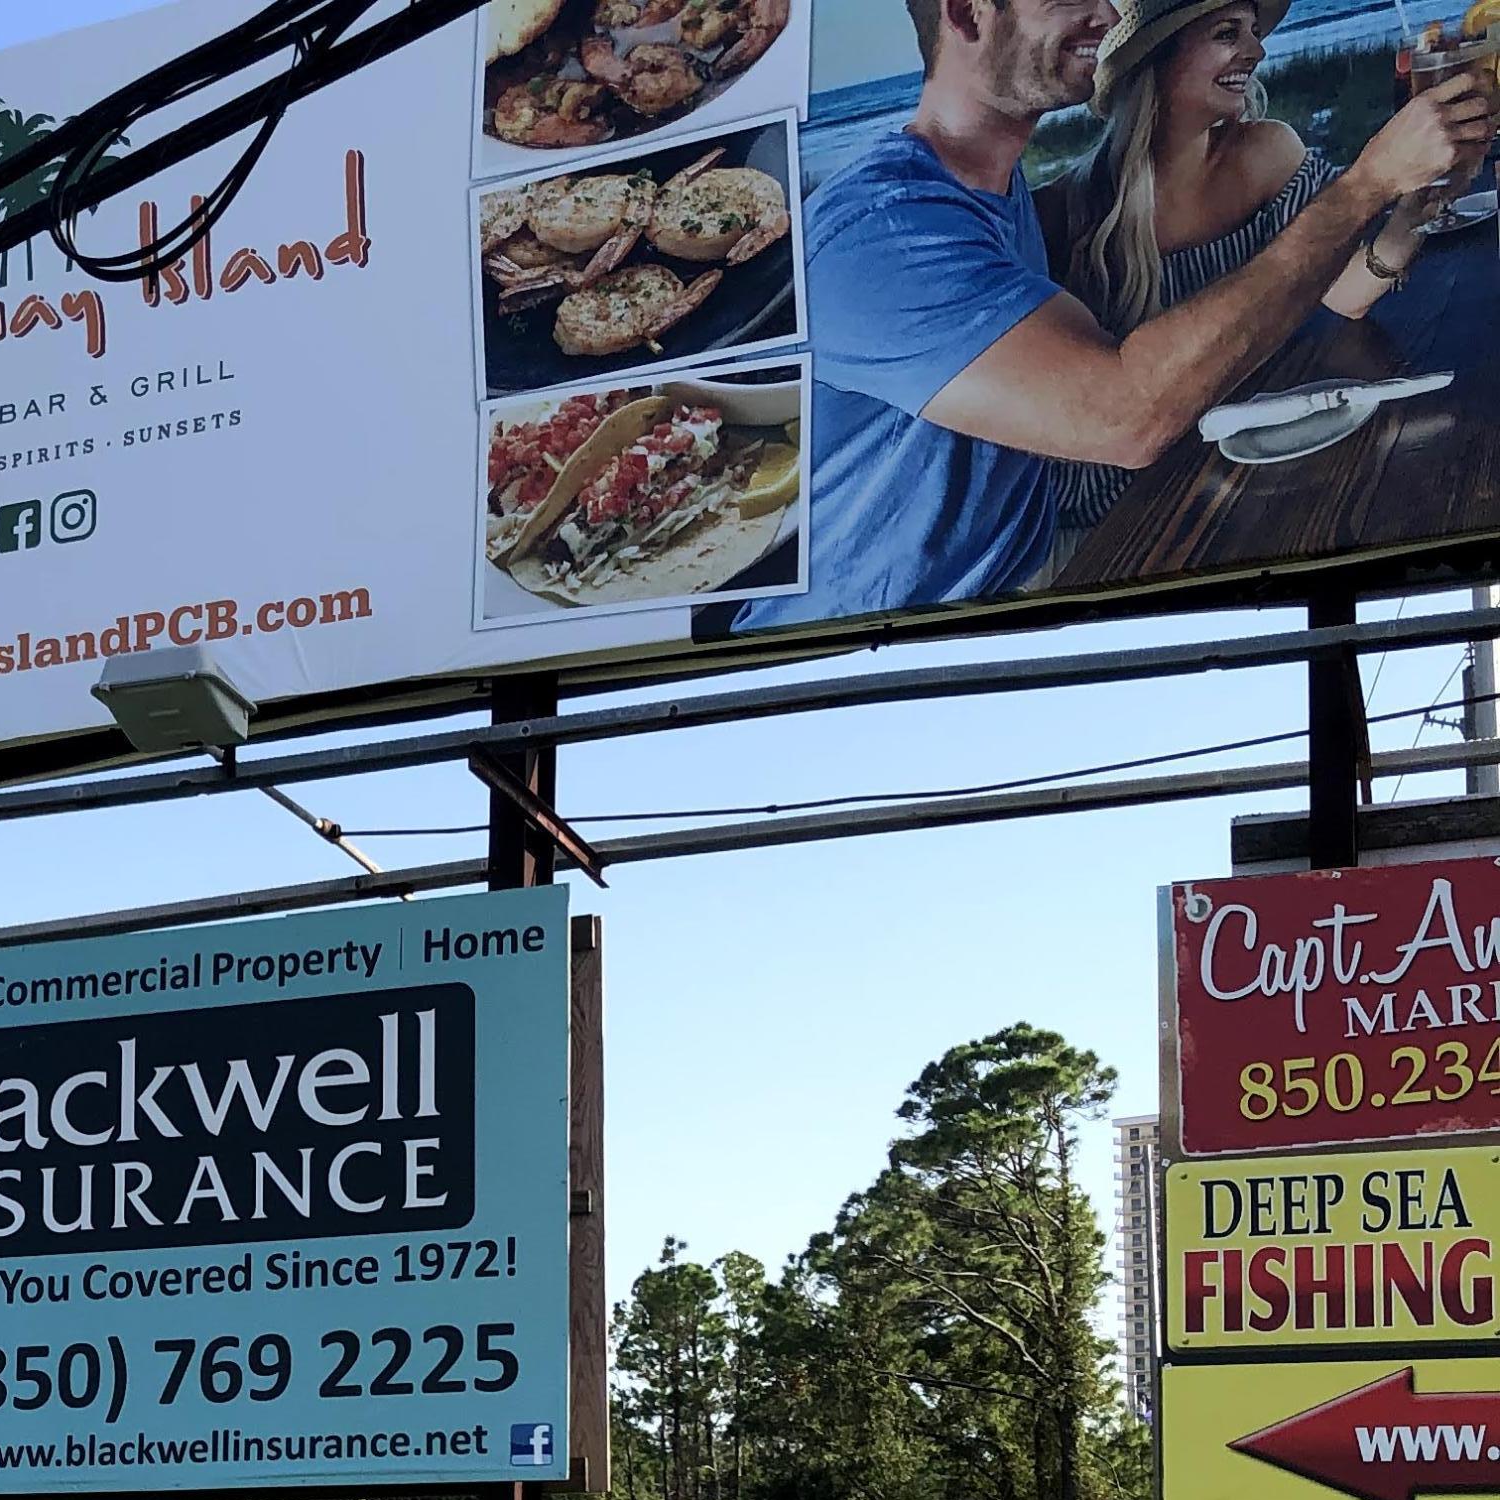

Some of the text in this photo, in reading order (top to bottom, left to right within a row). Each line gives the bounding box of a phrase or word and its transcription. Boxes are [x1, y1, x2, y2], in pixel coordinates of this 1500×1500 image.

[138, 149, 371, 308] Island
[0, 394, 65, 424] BAR
[90, 385, 107, 405] &
[131, 361, 234, 397] GRILL
[124, 410, 240, 446] SUNSETS
[213, 941, 382, 987] Property
[425, 926, 544, 962] Home
[1200, 904, 1377, 1032] Capt.
[1342, 980, 1500, 1038] MAR
[1200, 1168, 1473, 1238] DEEP SEA
[0, 1269, 69, 1304] You
[83, 1253, 251, 1300] Covered
[266, 1251, 378, 1290] Since
[394, 1237, 516, 1282] 1972!
[1183, 1238, 1494, 1333] FISHING
[155, 1334, 291, 1404] 769
[320, 1323, 518, 1397] 2225
